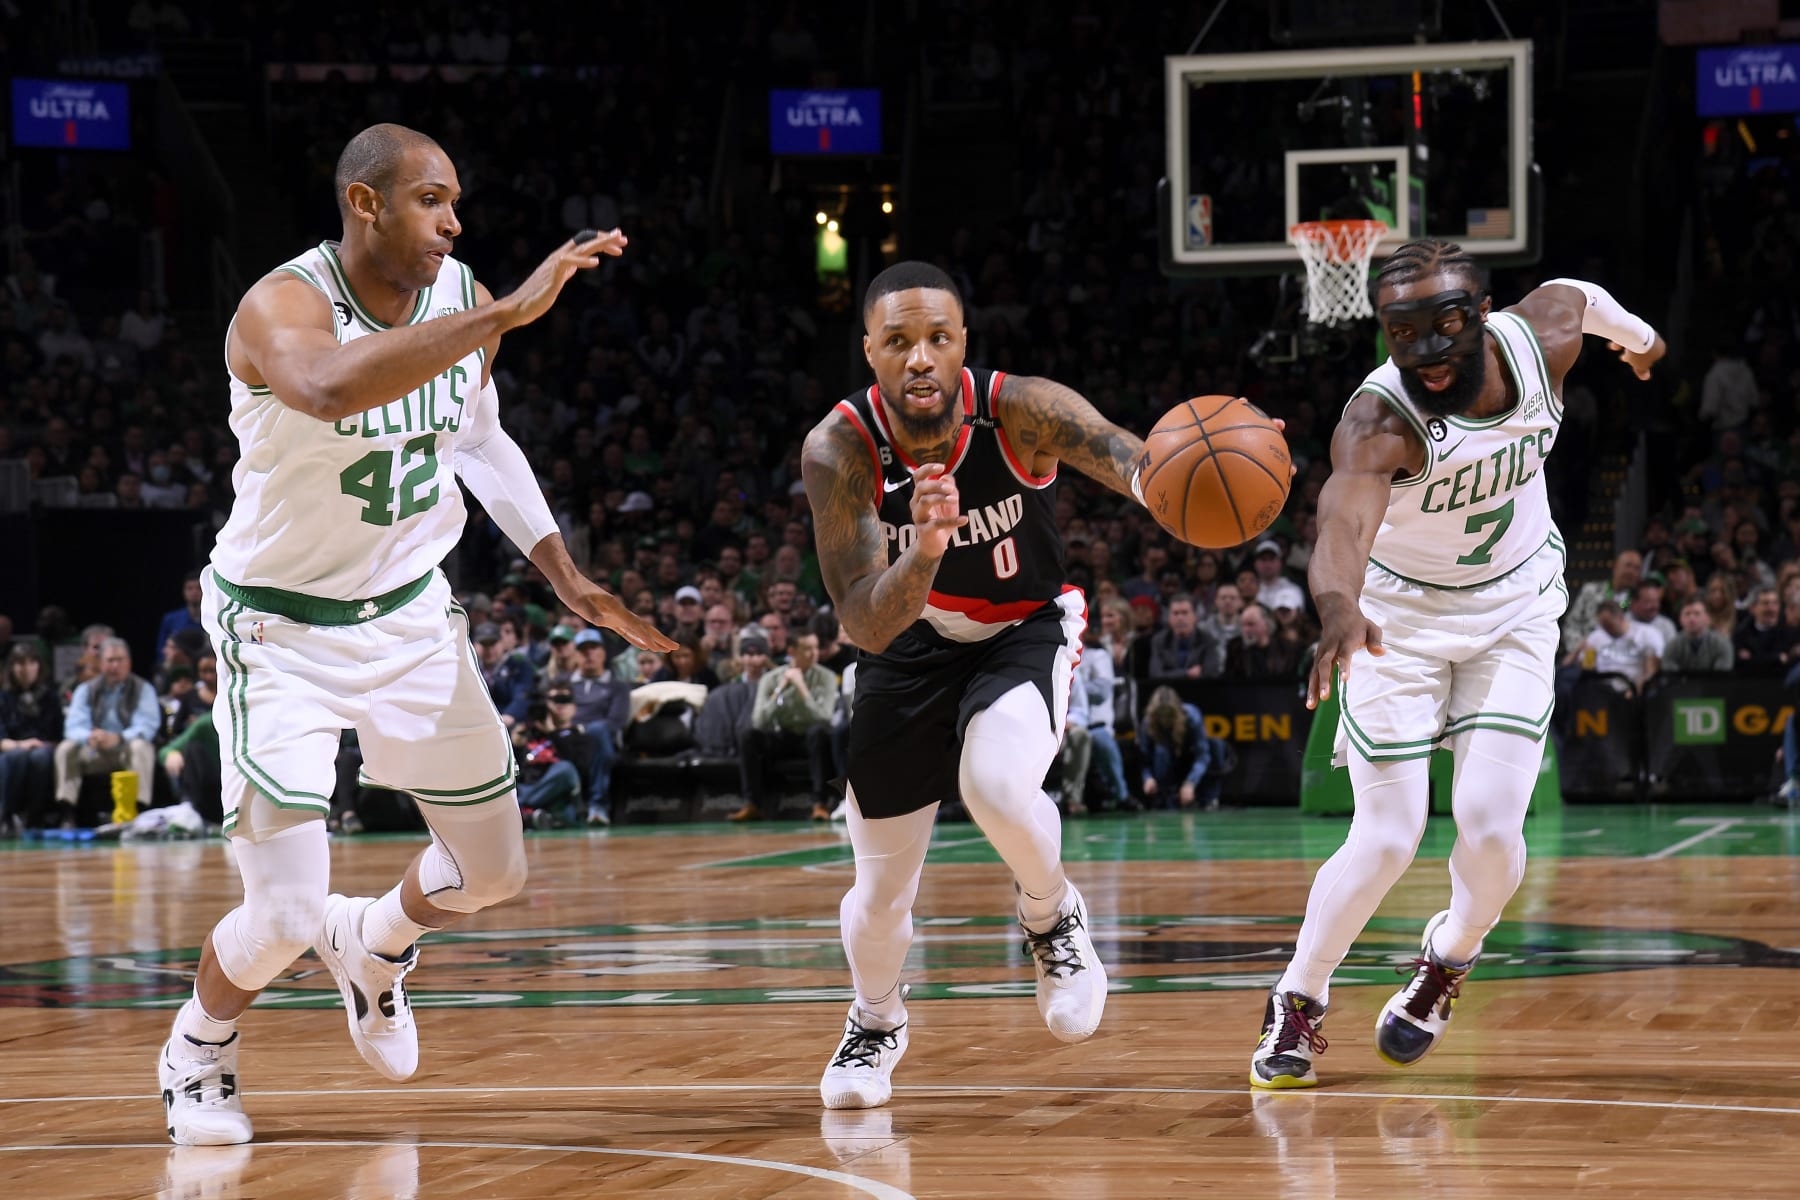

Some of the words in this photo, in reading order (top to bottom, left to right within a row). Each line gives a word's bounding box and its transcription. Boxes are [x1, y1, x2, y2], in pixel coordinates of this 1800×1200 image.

[1714, 62, 1798, 87] ULTRA
[30, 97, 110, 119] ULTRA
[786, 106, 863, 127] ULTRA
[1523, 391, 1544, 414] VISTA
[1523, 402, 1545, 424] PRINT
[1429, 420, 1447, 441] 6
[879, 446, 893, 465] 6
[340, 432, 440, 526] 42
[880, 493, 1024, 553] POLAND
[1455, 497, 1515, 566] 7
[992, 536, 1019, 580] 0
[1204, 714, 1292, 741] DEN
[1679, 706, 1721, 736] TD
